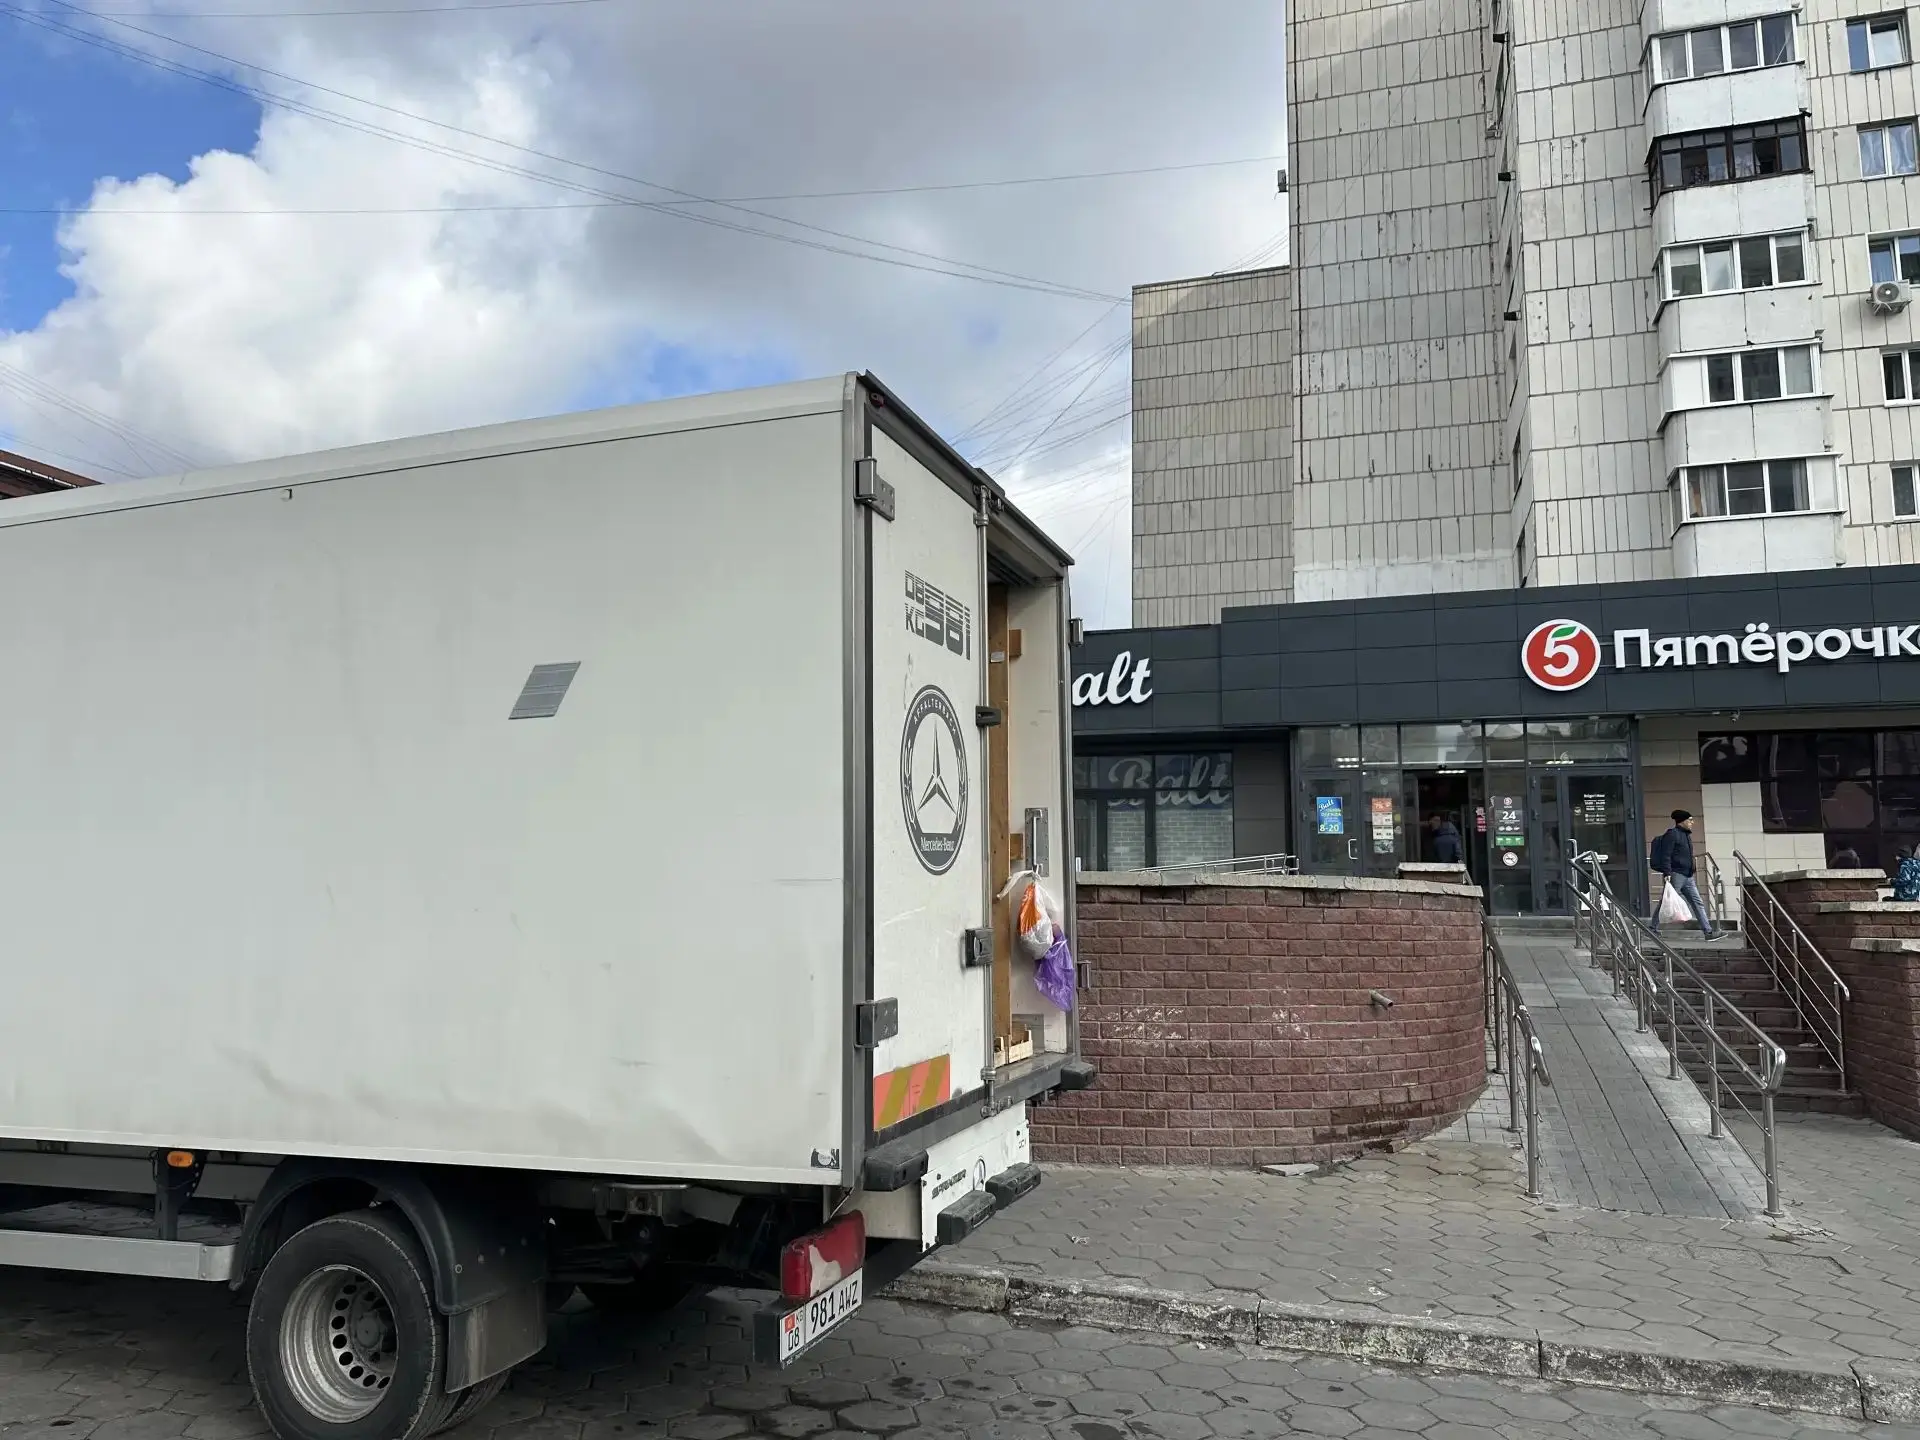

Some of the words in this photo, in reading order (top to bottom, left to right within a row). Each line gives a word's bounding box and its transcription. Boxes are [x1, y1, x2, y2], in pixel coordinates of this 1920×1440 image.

[1542, 628, 1580, 678] 5
[1613, 622, 1920, 674] Пятёрочк
[1071, 650, 1152, 706] alt
[912, 698, 957, 735] AFFALTERBACH
[1108, 756, 1231, 806] Balt
[1319, 823, 1340, 832] 8-20
[1502, 810, 1517, 820] 24
[920, 836, 955, 853] Mercedes-Benz
[787, 1327, 800, 1351] 08
[811, 1291, 836, 1335] 981
[838, 1280, 859, 1316] AWZ
